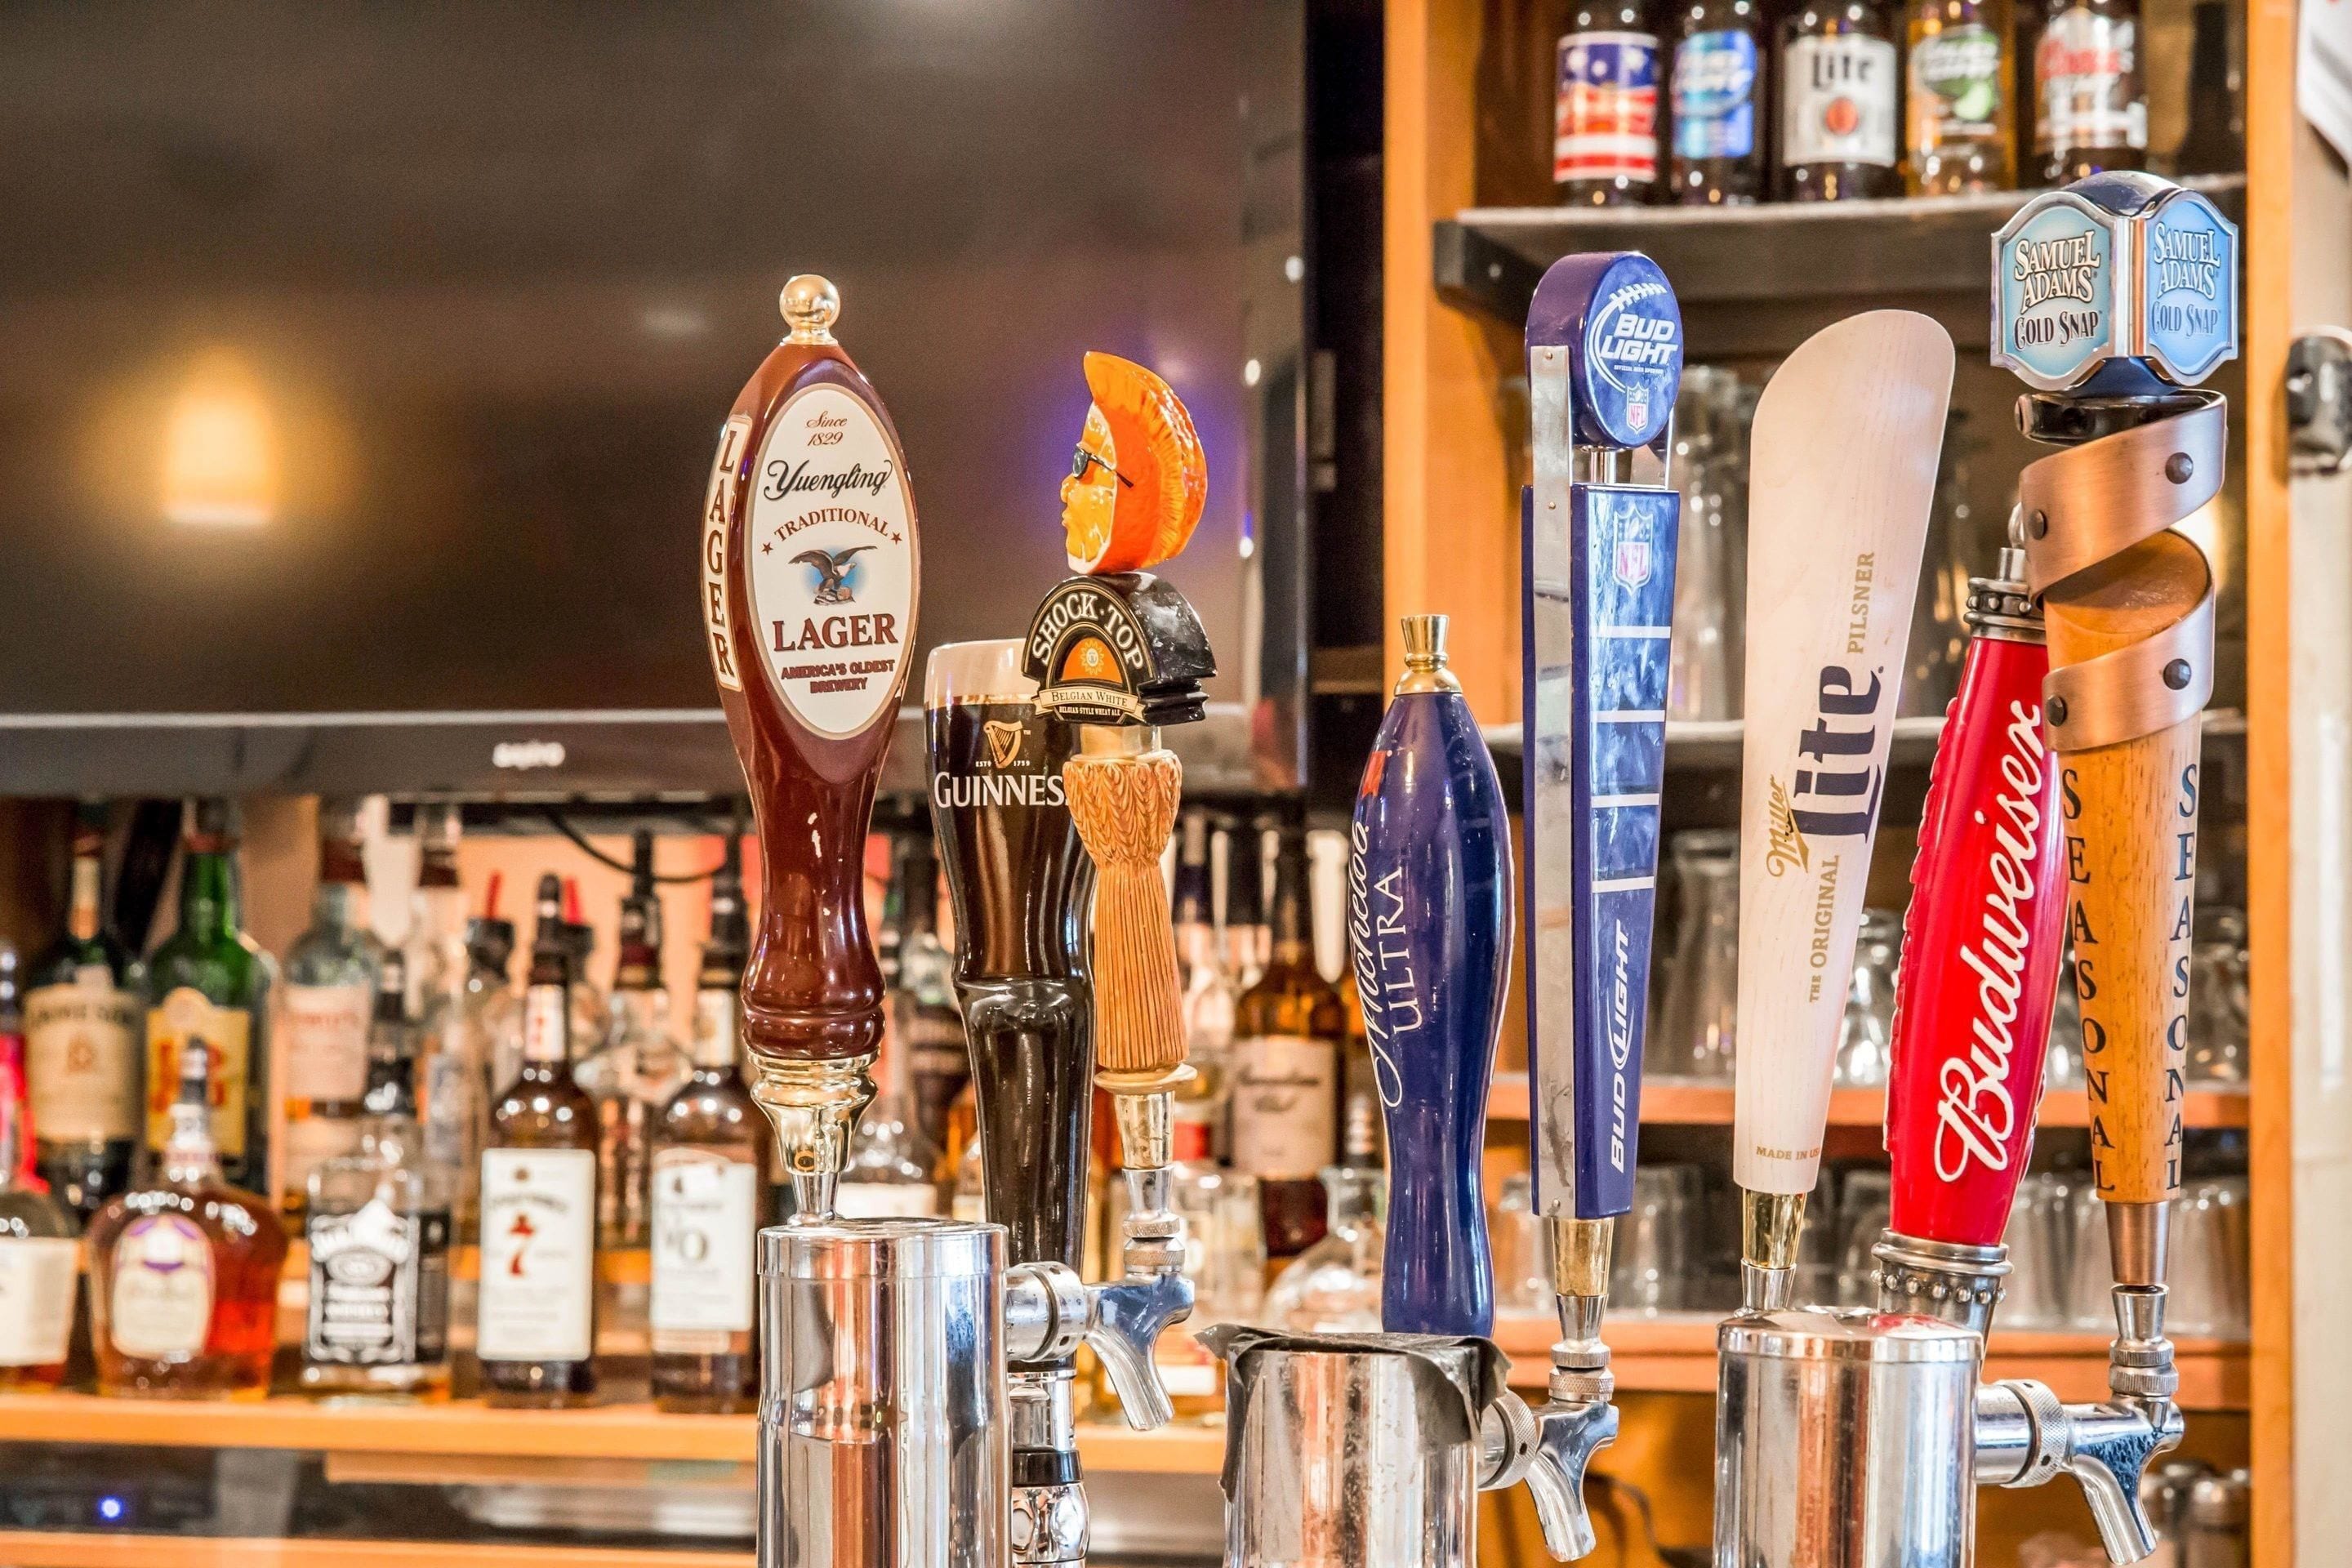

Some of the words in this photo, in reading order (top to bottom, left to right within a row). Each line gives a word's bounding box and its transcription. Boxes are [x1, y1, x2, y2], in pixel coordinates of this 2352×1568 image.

[2014, 229, 2101, 281] SAMUEL
[2154, 221, 2221, 268] SAMUEL
[2020, 265, 2094, 314] ADAMS
[2157, 260, 2216, 301] ADAMS
[1614, 313, 1675, 341] BUD
[2013, 315, 2055, 352] COLD
[2060, 310, 2100, 345] SNAP
[2151, 301, 2182, 335] COLD
[2186, 304, 2218, 336] SNAP
[1600, 335, 1678, 365] LIGHT
[806, 411, 848, 429] Since
[1628, 403, 1646, 425] NFL
[807, 431, 844, 447] 1829
[764, 460, 893, 501] Yuengling
[774, 508, 889, 541] TRADITIONAL
[707, 430, 737, 679] LAGER
[1618, 544, 1647, 578] NFL
[1847, 551, 1875, 654] PILSNER
[773, 613, 898, 652] LAGER
[1032, 592, 1098, 666] SHOCK
[1103, 604, 1144, 670] TOP
[781, 663, 848, 679] AMERICA'S
[849, 659, 895, 675] OLDEST
[810, 677, 868, 694] BREWERY
[1051, 692, 1093, 702] BELGIAN
[1096, 691, 1128, 706] WHITE
[1793, 666, 1882, 844] Lite
[934, 771, 1069, 808] GUINNES
[1766, 773, 1805, 879] Miller
[1810, 855, 1839, 969] ORIGINAL
[1374, 866, 1423, 1035] ULTRA
[1933, 699, 2045, 1184] Budweiser
[1348, 819, 1403, 1108] Michelob
[2061, 768, 2115, 1192] SEASONAL
[1613, 918, 1629, 1053] LIGHT
[1809, 975, 1822, 1003] THE
[1610, 1071, 1625, 1174] BUD
[1756, 1146, 1793, 1160] MADE
[1796, 1151, 1808, 1160] IN
